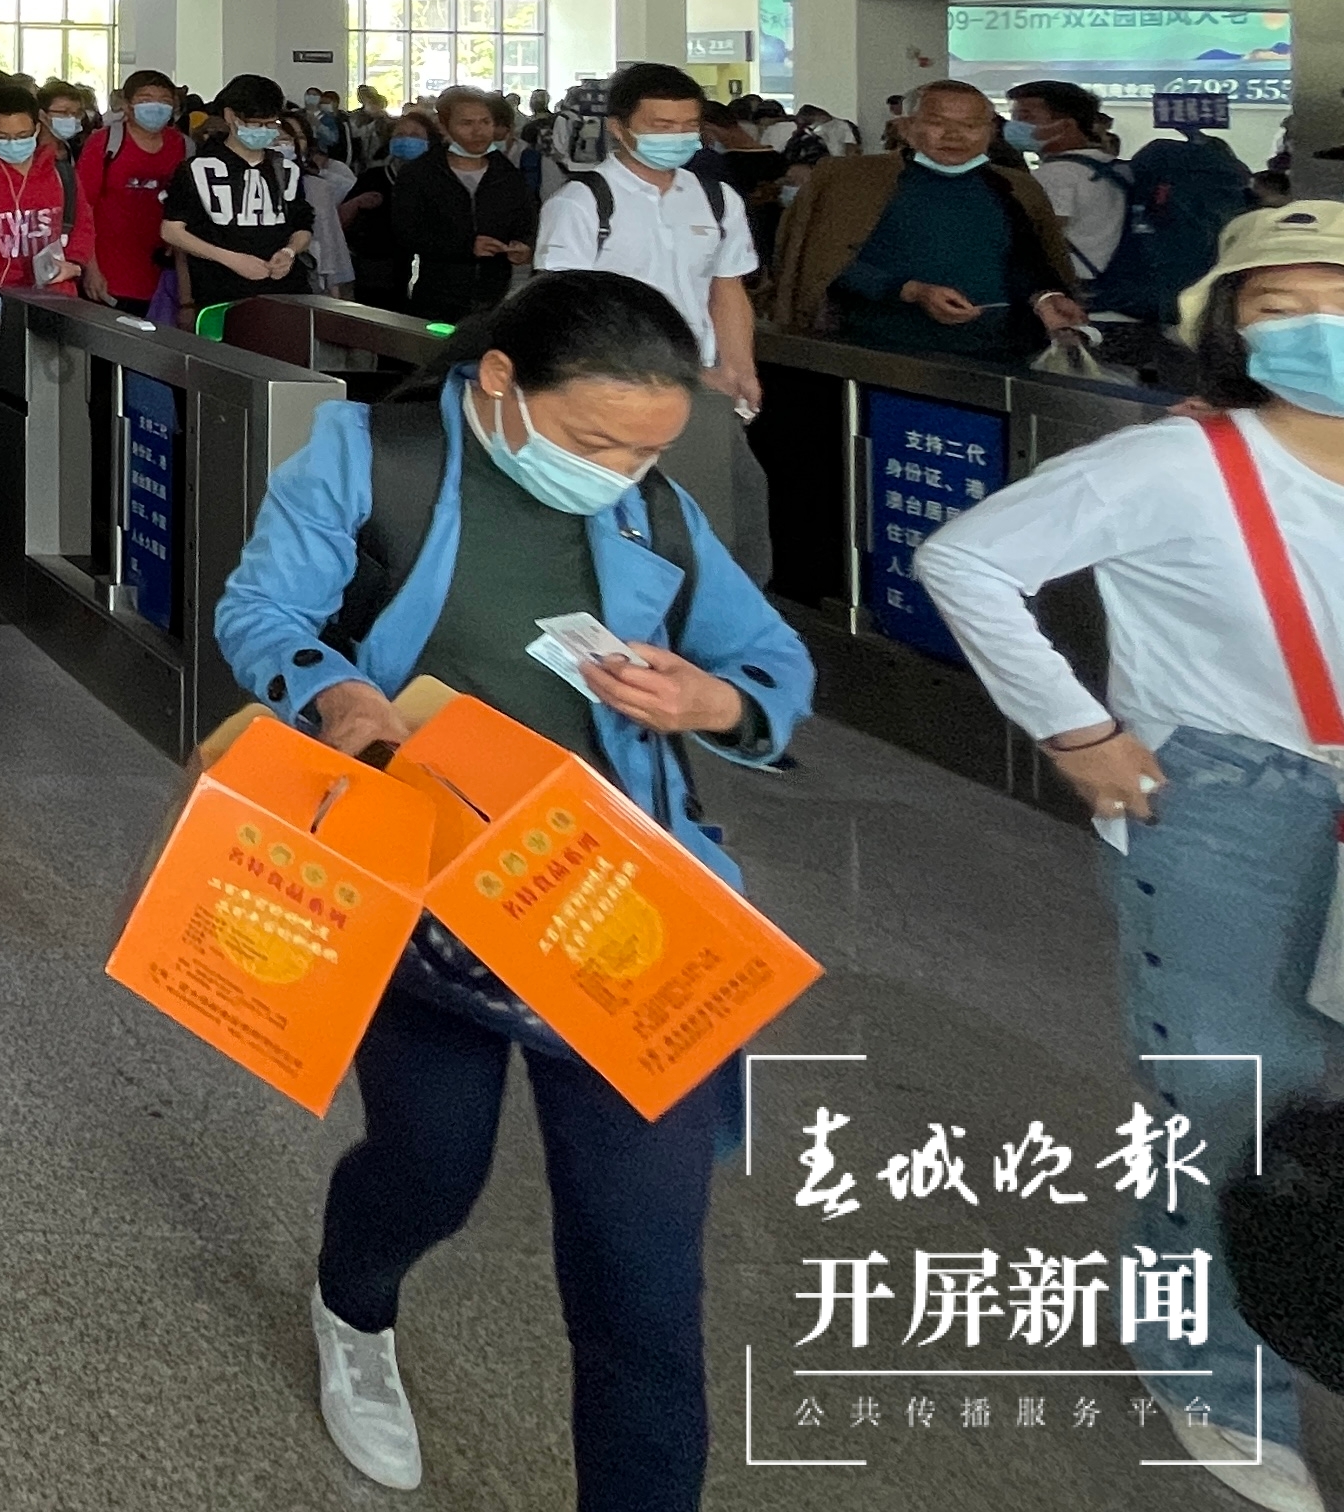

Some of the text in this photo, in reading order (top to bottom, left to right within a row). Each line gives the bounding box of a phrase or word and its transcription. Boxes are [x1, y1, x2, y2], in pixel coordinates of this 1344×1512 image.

[190, 157, 301, 227] GAP
[905, 430, 987, 467] 支持二代
